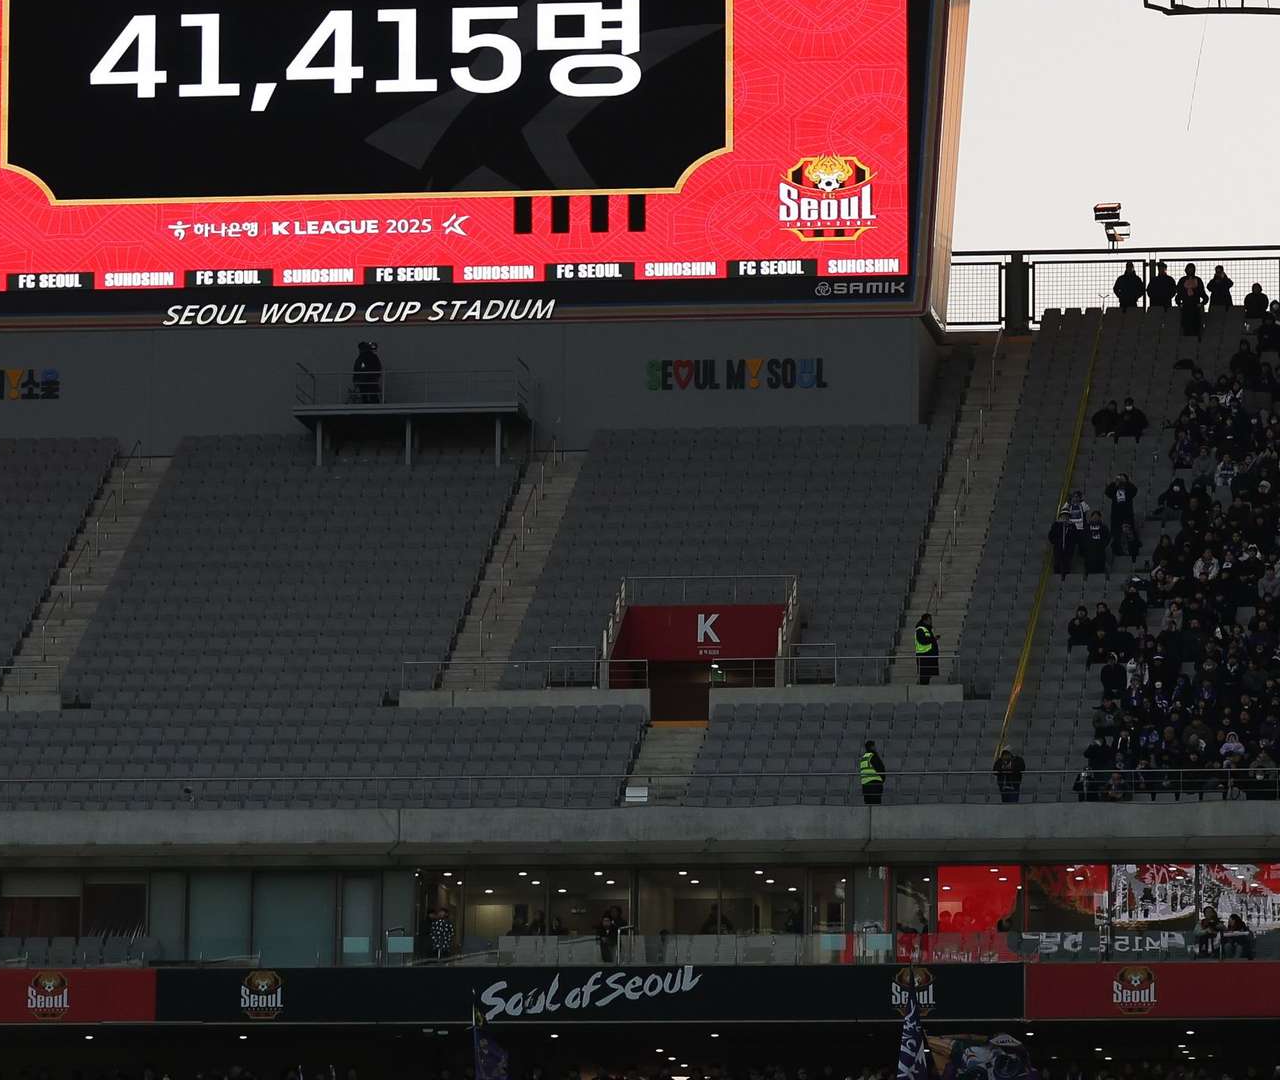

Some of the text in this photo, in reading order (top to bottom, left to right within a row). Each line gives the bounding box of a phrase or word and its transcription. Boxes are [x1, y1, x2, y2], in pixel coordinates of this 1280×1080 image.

[193, 218, 433, 238] 하나은행 K LEAGUE 2025
[18, 274, 36, 289] FC
[39, 273, 83, 289] SEOUL
[104, 271, 174, 287] SUHOSHIN
[196, 270, 214, 286] FC
[217, 269, 261, 285] SEOUL
[282, 267, 354, 283] SUHOSHIN
[375, 267, 394, 282] FC
[397, 266, 441, 282] SEOUL
[463, 264, 535, 281] SUHOSHIN
[556, 263, 574, 279] FC
[578, 263, 623, 278] SEOUL
[644, 261, 717, 277] SUHOSHIN
[738, 260, 757, 276] FC
[760, 260, 805, 276] SEOUL
[827, 258, 899, 274] SUHOSHIN
[833, 282, 906, 295] SAMIK
[162, 299, 556, 326] SEOUL WORLD CUP STADIUM
[697, 613, 721, 643] K
